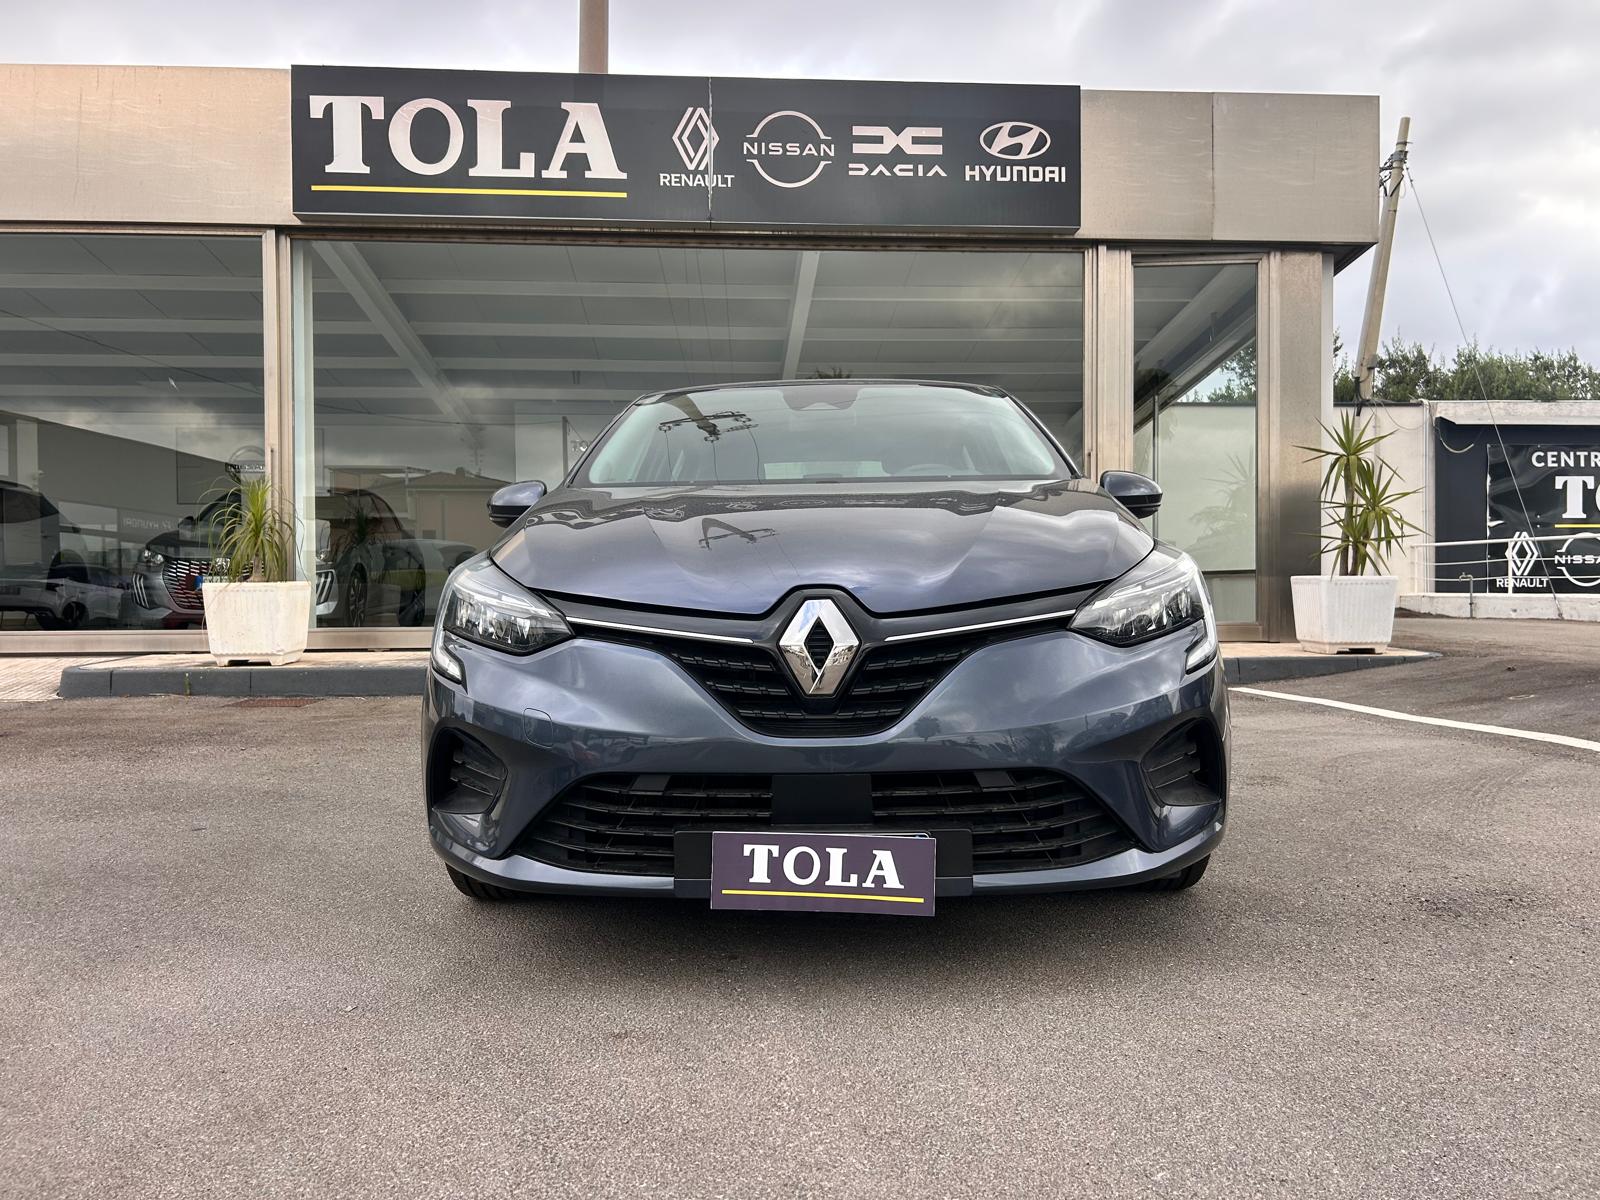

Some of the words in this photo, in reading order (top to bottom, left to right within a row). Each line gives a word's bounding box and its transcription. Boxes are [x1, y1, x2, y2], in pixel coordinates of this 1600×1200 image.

[309, 95, 628, 180] TOLA
[743, 141, 835, 157] NISSAN
[848, 163, 948, 177] DACIA
[965, 165, 1067, 183] HYUNDAI
[659, 173, 735, 188] RENAULT
[1554, 475, 1600, 519] T
[743, 844, 905, 890] TOLA
